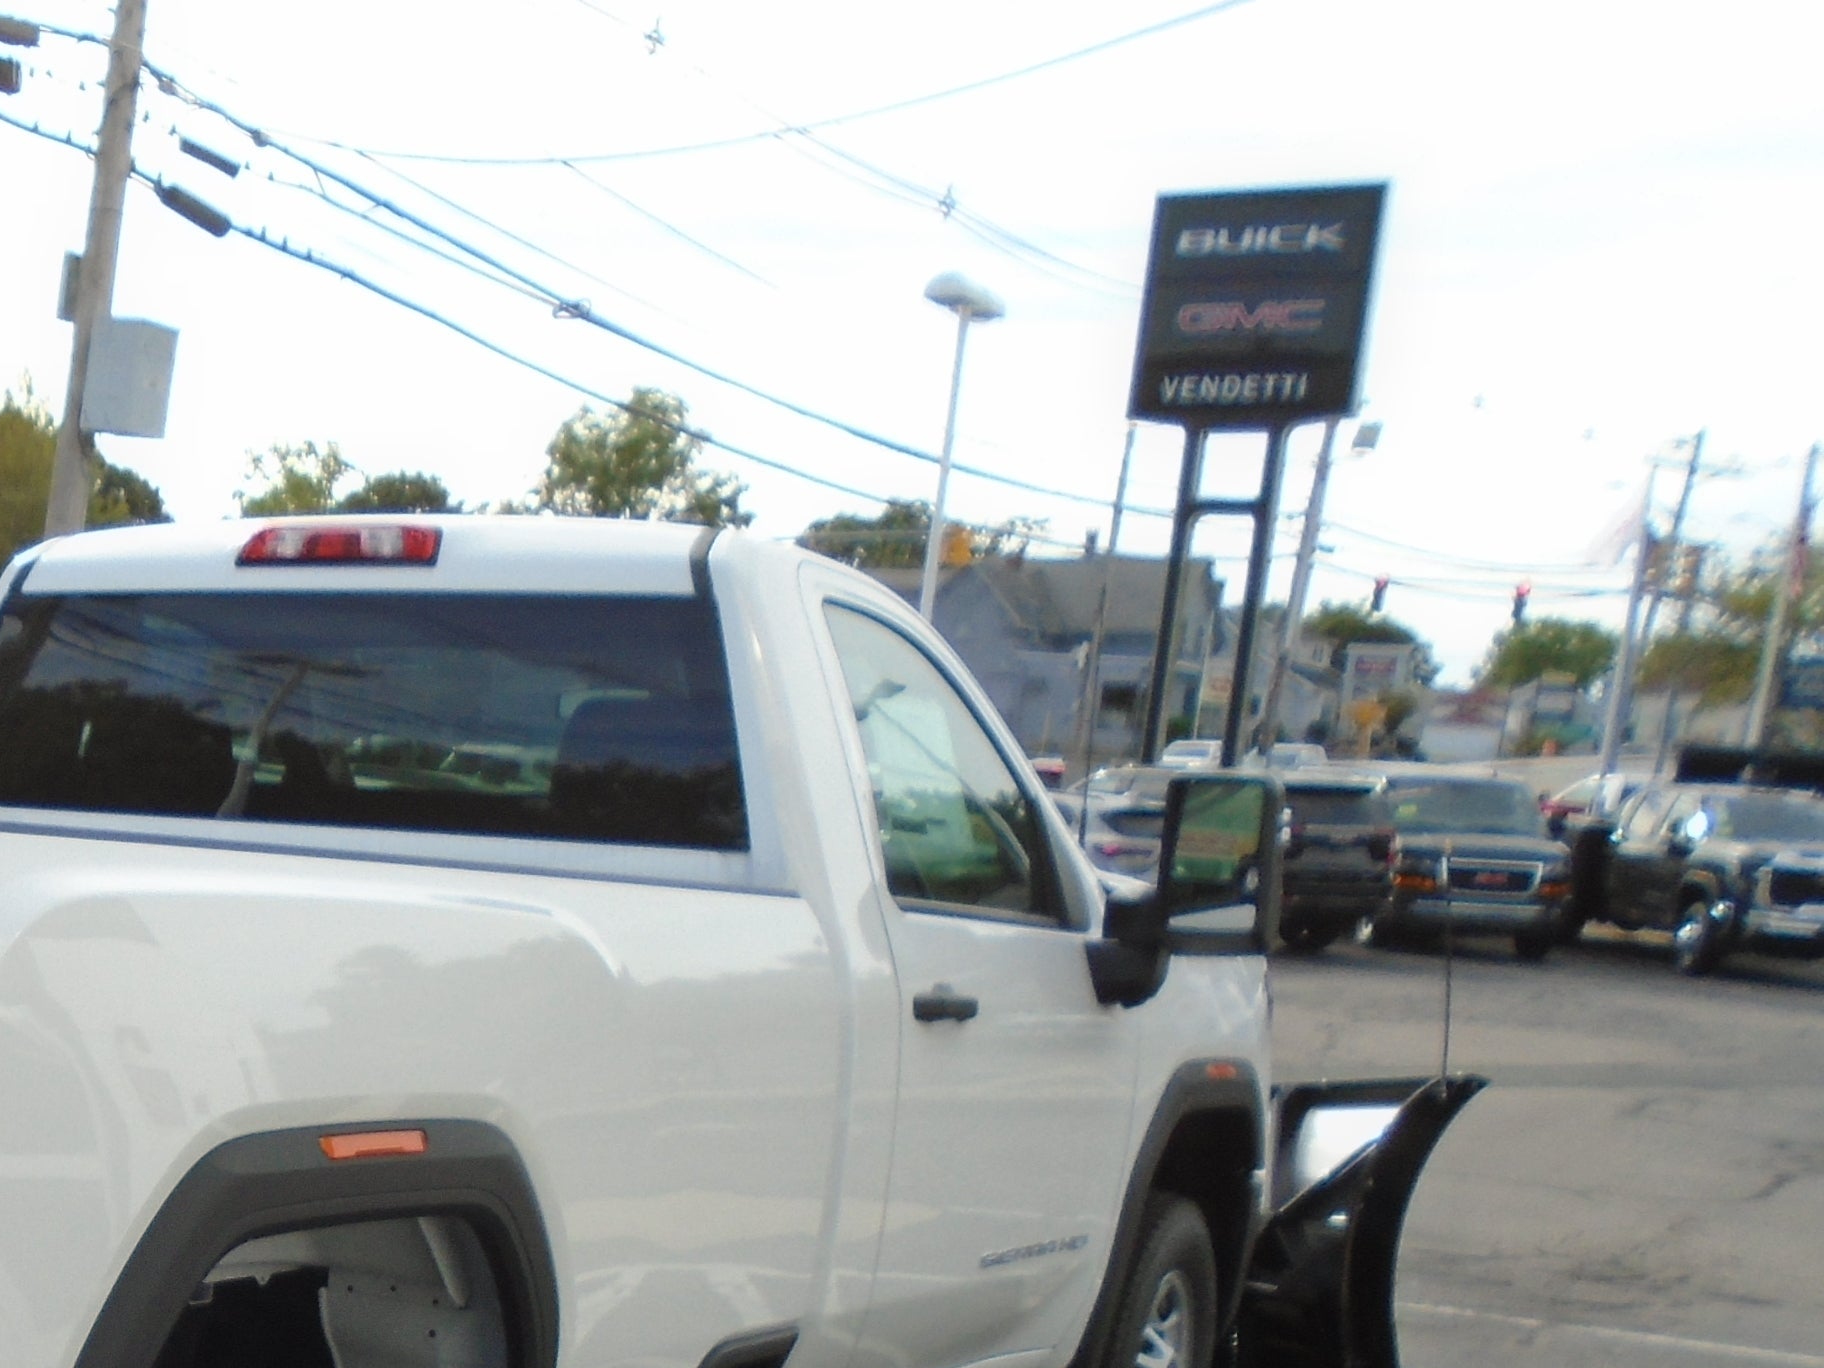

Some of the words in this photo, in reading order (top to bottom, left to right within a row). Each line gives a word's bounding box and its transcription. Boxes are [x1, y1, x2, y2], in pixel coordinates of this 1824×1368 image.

[1176, 222, 1346, 254] BUICK
[1177, 299, 1326, 333] GMC
[1160, 371, 1310, 402] VENDETTI
